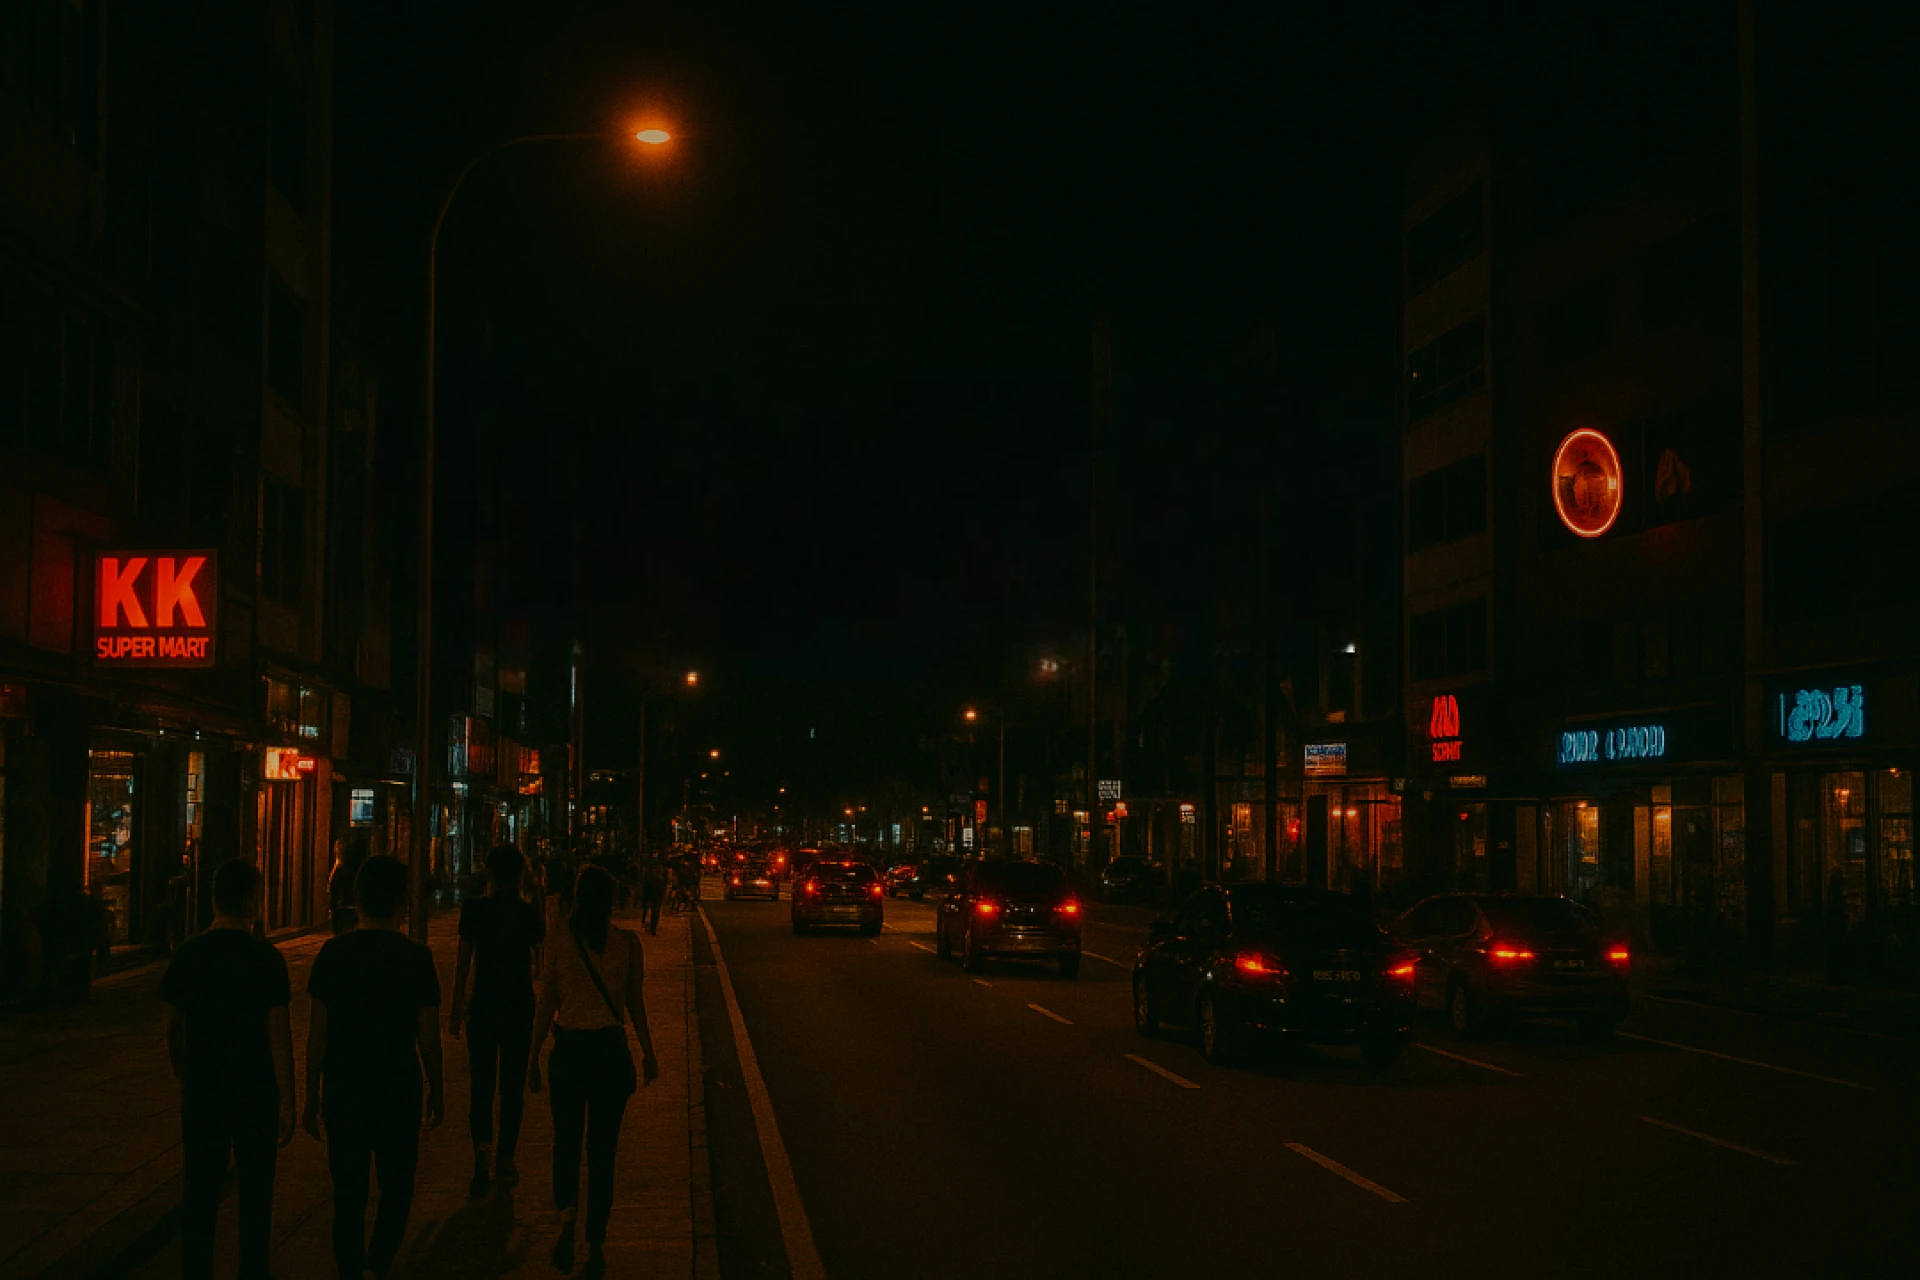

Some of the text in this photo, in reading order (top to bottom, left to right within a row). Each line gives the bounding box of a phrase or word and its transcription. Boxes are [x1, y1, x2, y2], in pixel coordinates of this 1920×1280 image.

[101, 557, 206, 627] KK
[98, 636, 209, 658] SUPER MART
